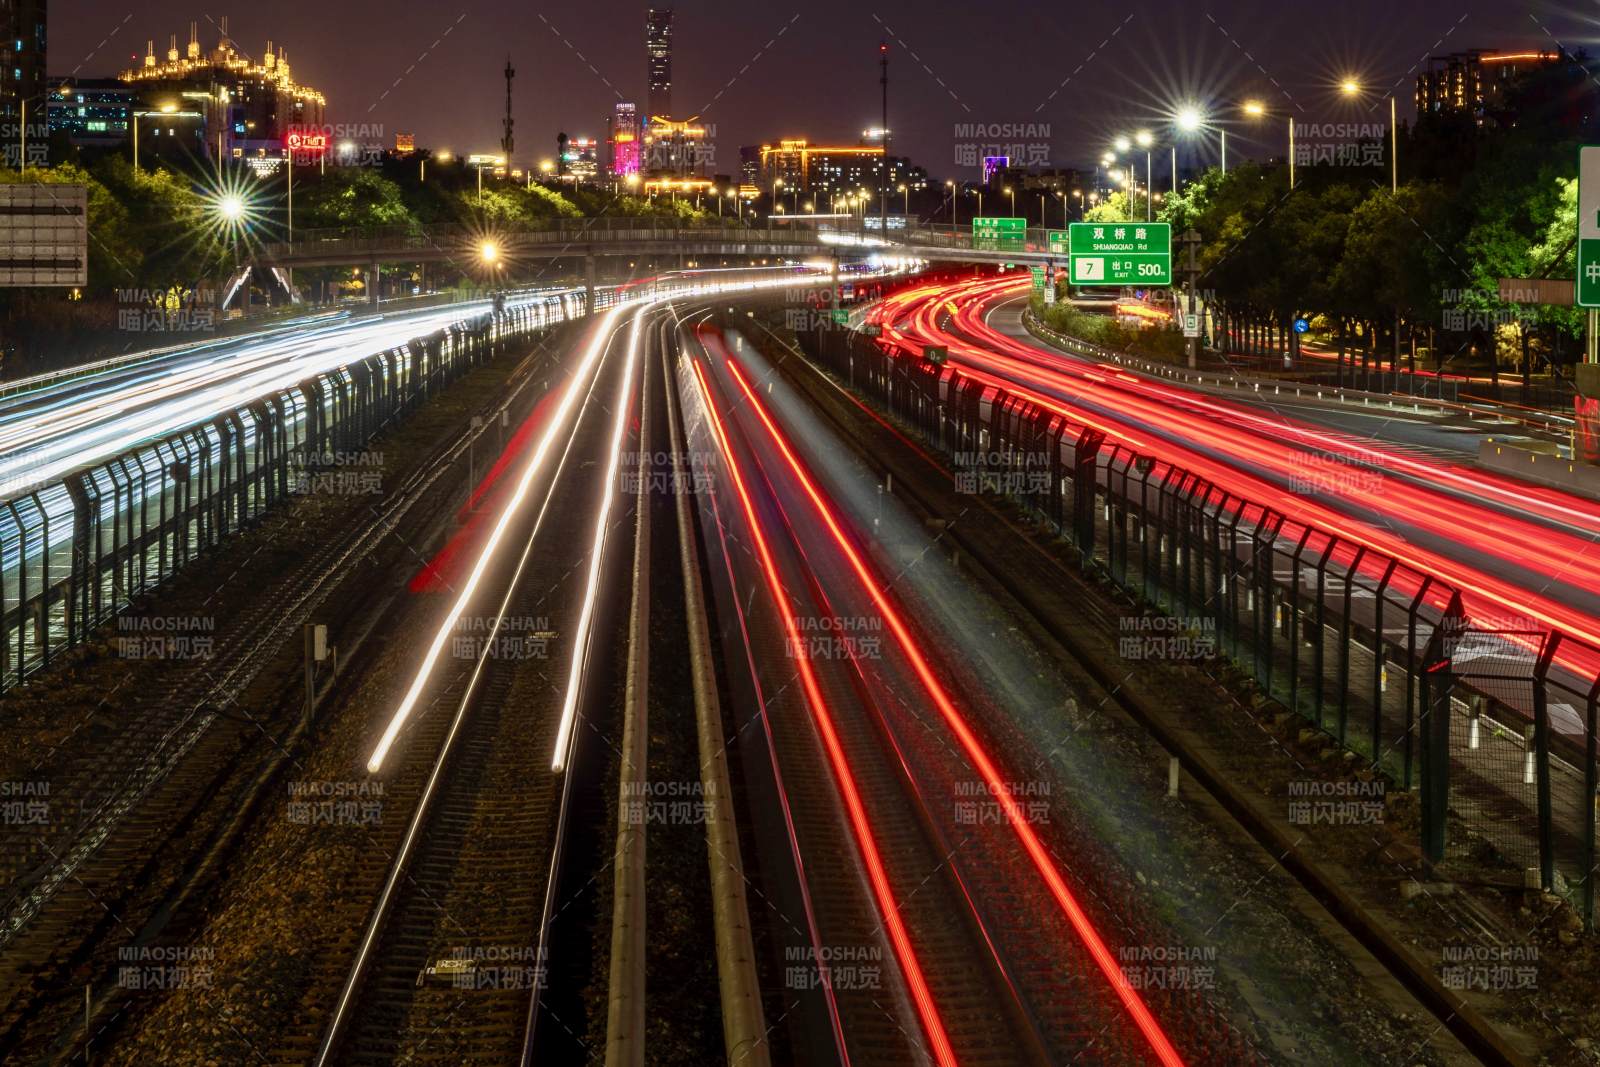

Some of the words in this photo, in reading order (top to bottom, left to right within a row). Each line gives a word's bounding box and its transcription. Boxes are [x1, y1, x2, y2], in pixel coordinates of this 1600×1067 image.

[1092, 227, 1147, 240] 双桥路
[1092, 243, 1134, 251] SHUANGQIAO
[1086, 263, 1094, 275] 7
[1112, 261, 1133, 271] 出口
[1585, 260, 1600, 285] 中
